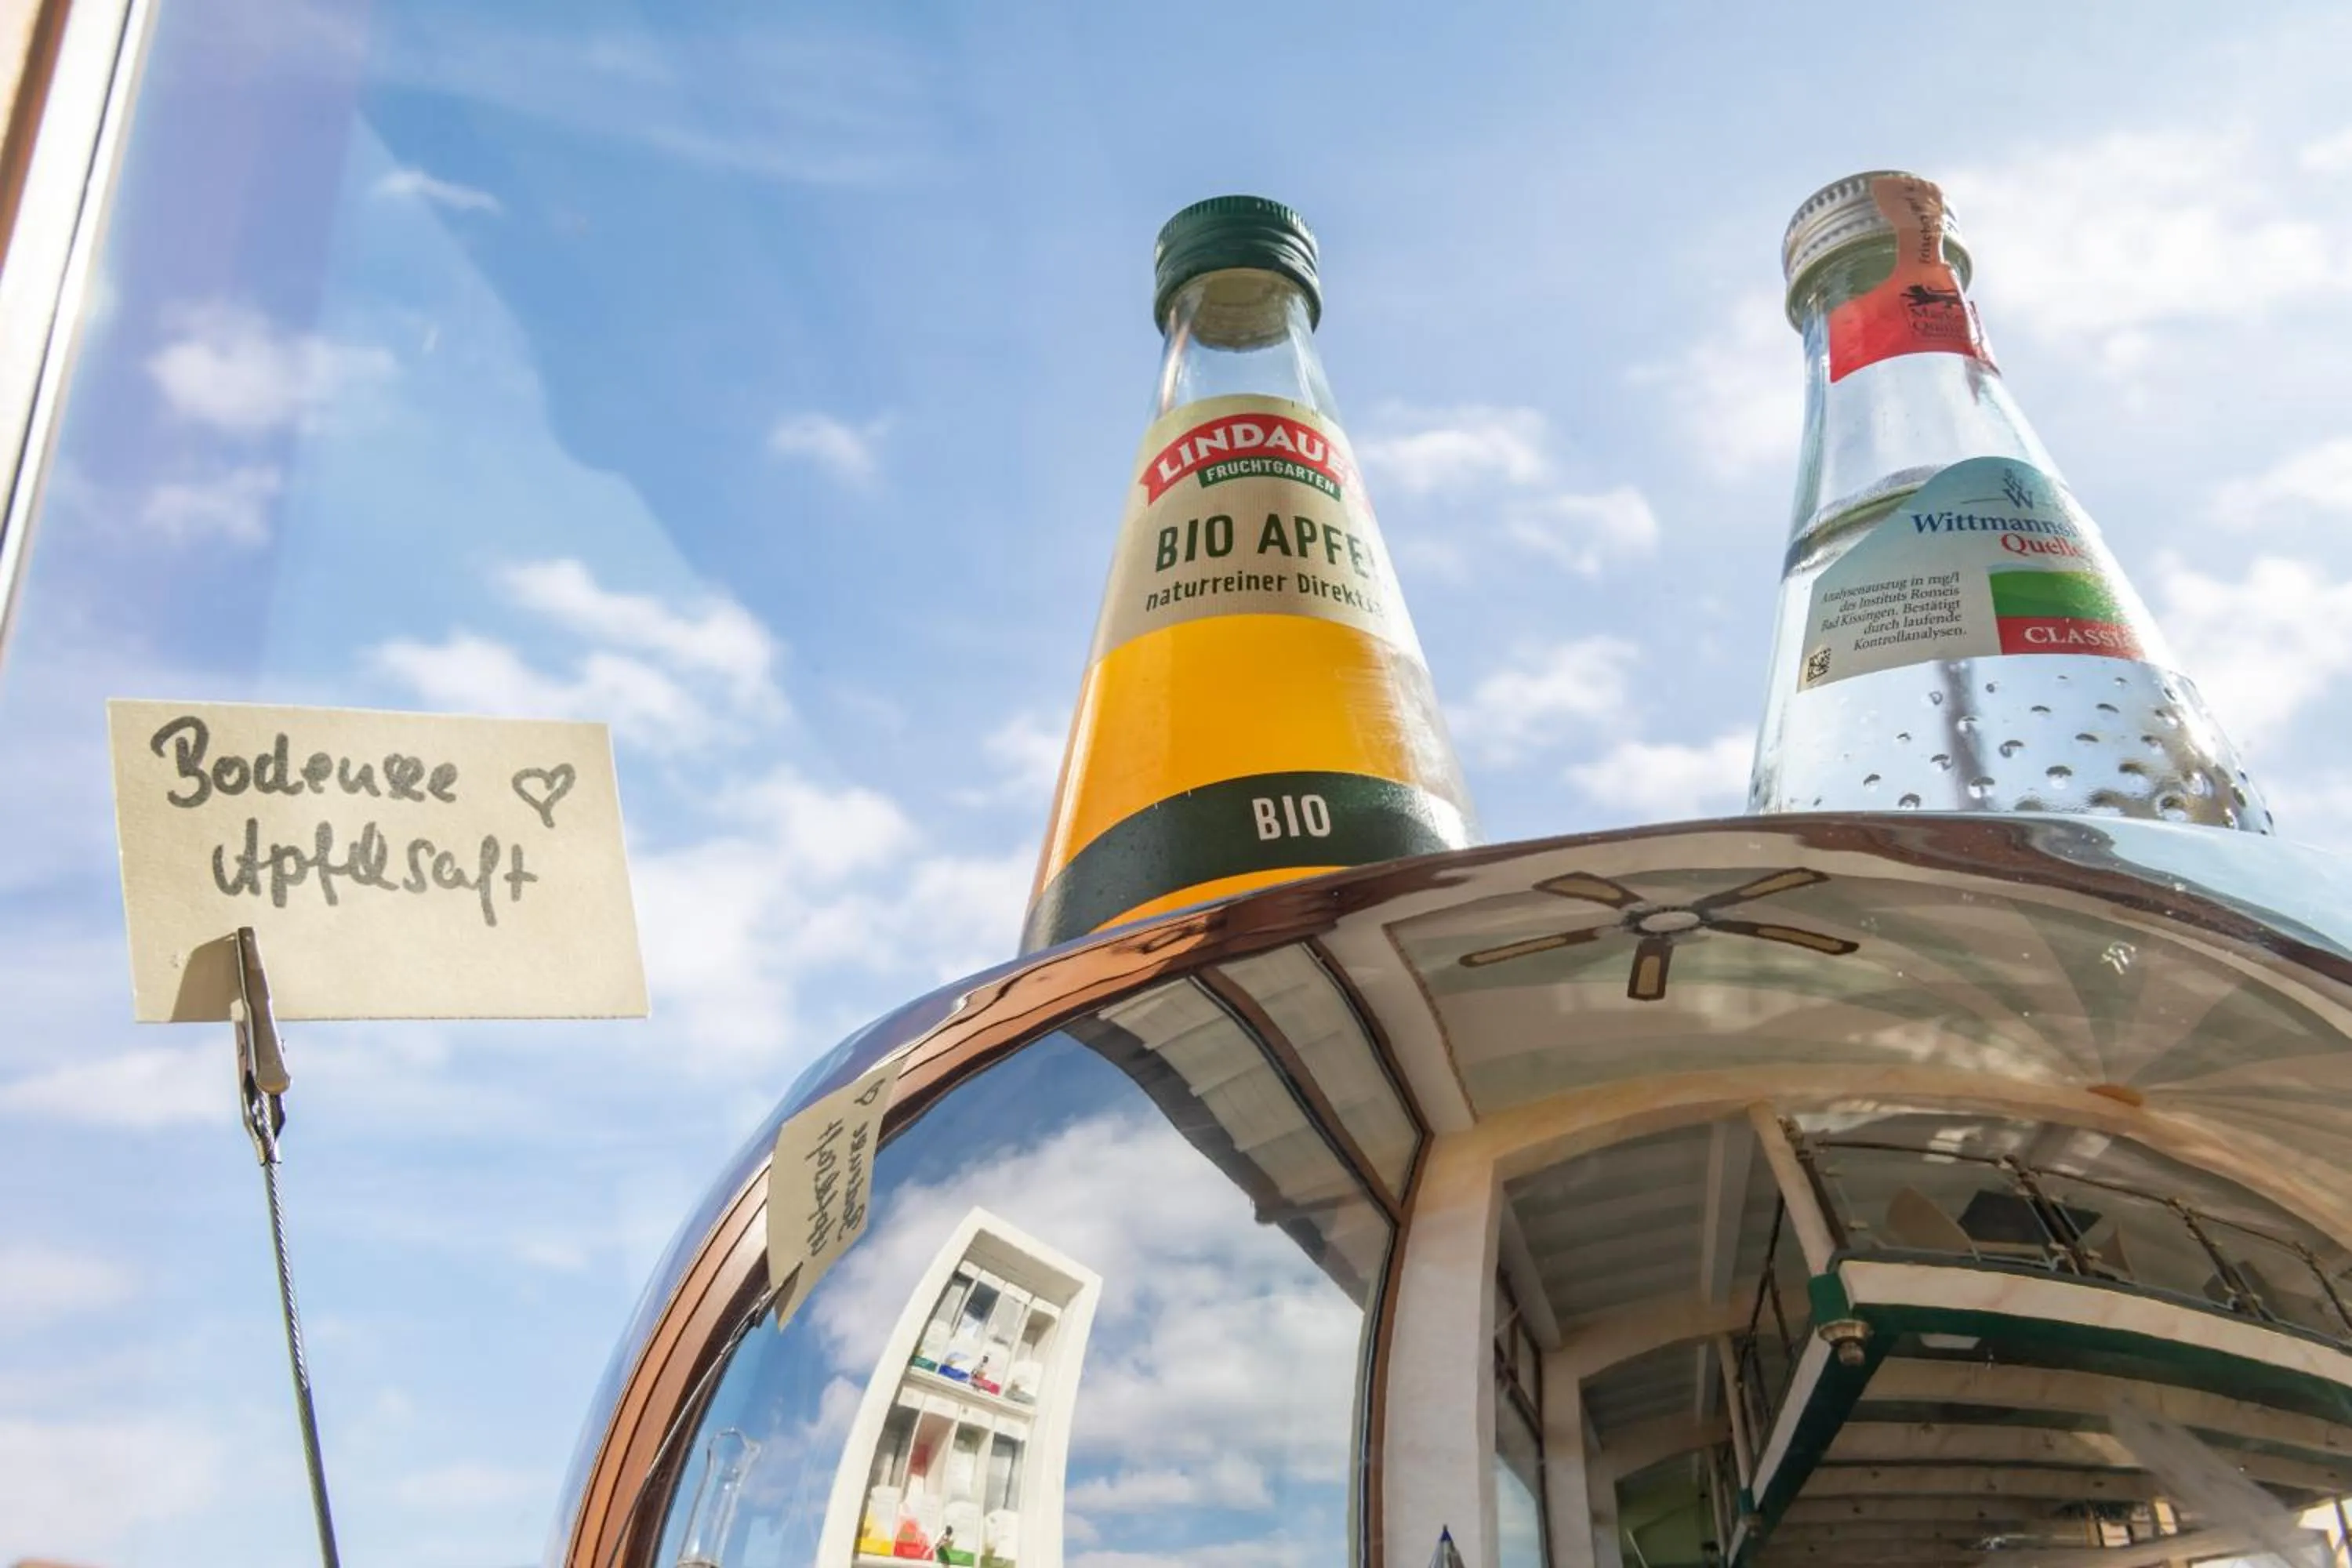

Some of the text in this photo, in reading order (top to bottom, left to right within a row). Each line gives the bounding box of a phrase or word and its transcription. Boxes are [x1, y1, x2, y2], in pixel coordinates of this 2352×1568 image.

[1156, 422, 1358, 489] LINDAUE
[1206, 459, 1336, 495] FRUCHTGARTEN
[1911, 511, 2078, 538] Wittmanns
[1156, 514, 1234, 572] BIO
[1145, 570, 1288, 612] naturreiner
[1911, 575, 1923, 586] in
[1928, 571, 1960, 585] mg/l
[1839, 600, 1856, 612] des
[1859, 591, 1907, 609] Instituts
[1903, 599, 1961, 614] Bestätigt
[1864, 611, 1962, 635] durch laufende
[1853, 626, 1967, 652] Kontrollanalysen.
[1252, 794, 1331, 840] BIO
